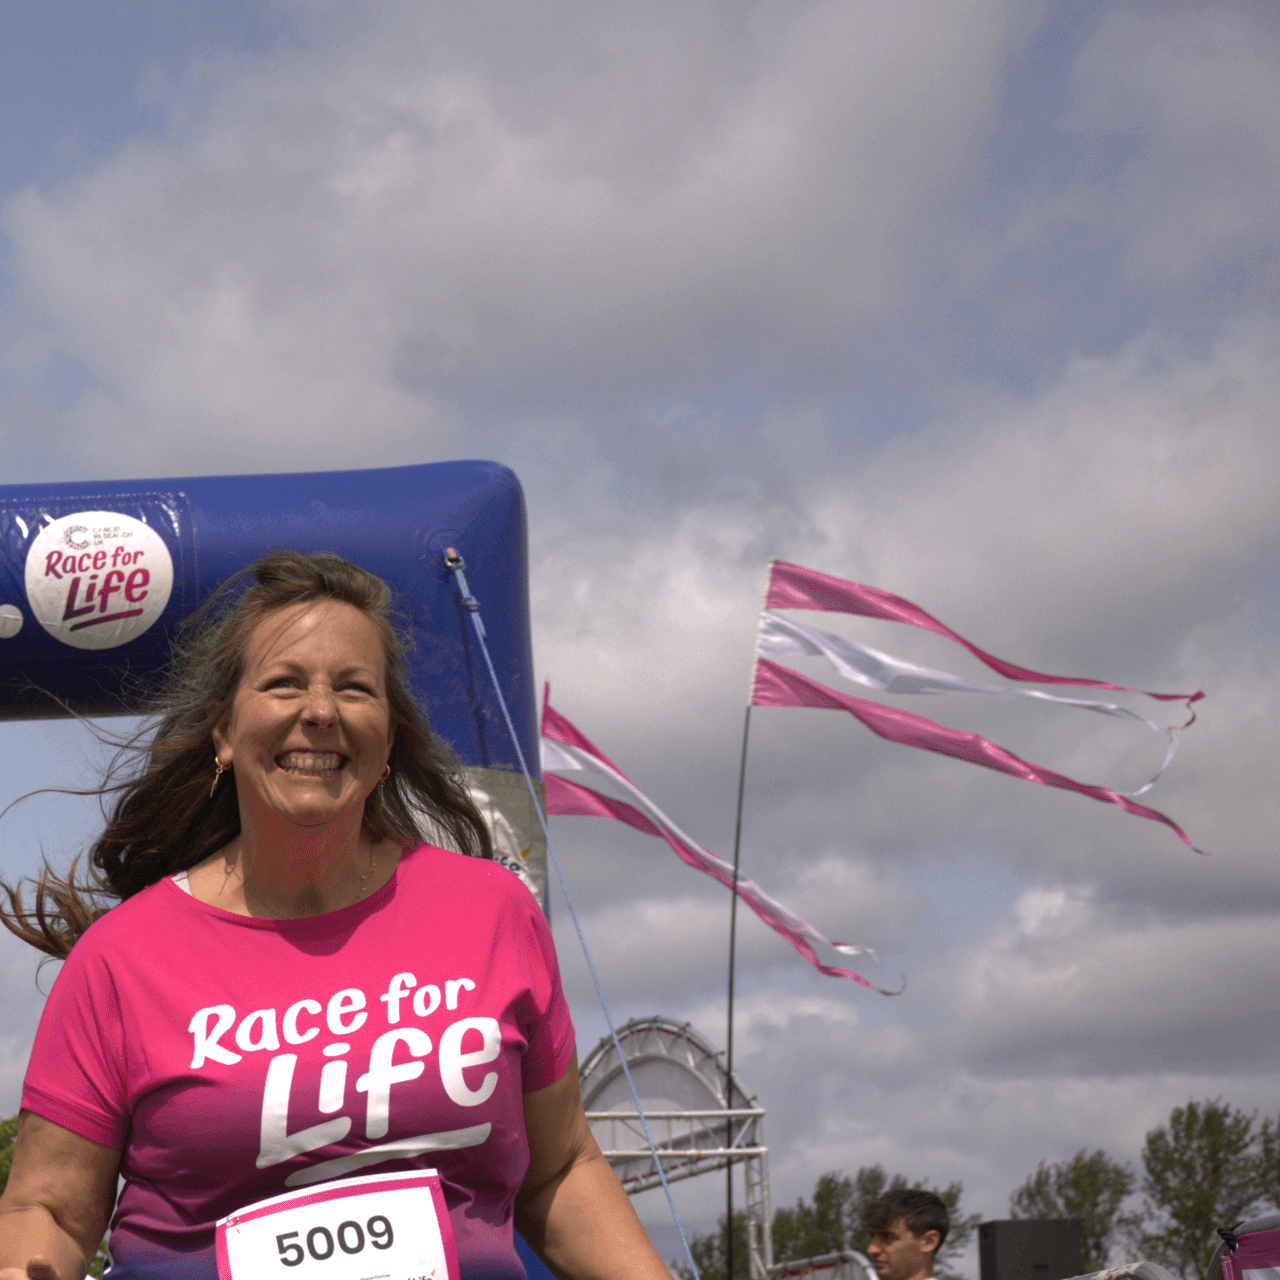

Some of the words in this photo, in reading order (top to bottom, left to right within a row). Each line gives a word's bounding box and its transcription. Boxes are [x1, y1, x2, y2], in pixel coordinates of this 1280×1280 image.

[45, 550, 107, 579] Race
[111, 546, 144, 568] for
[62, 568, 151, 621] Life
[188, 987, 368, 1069] Race
[380, 972, 476, 1024] for
[256, 1016, 502, 1170] Life
[275, 1214, 394, 1267] 5009
